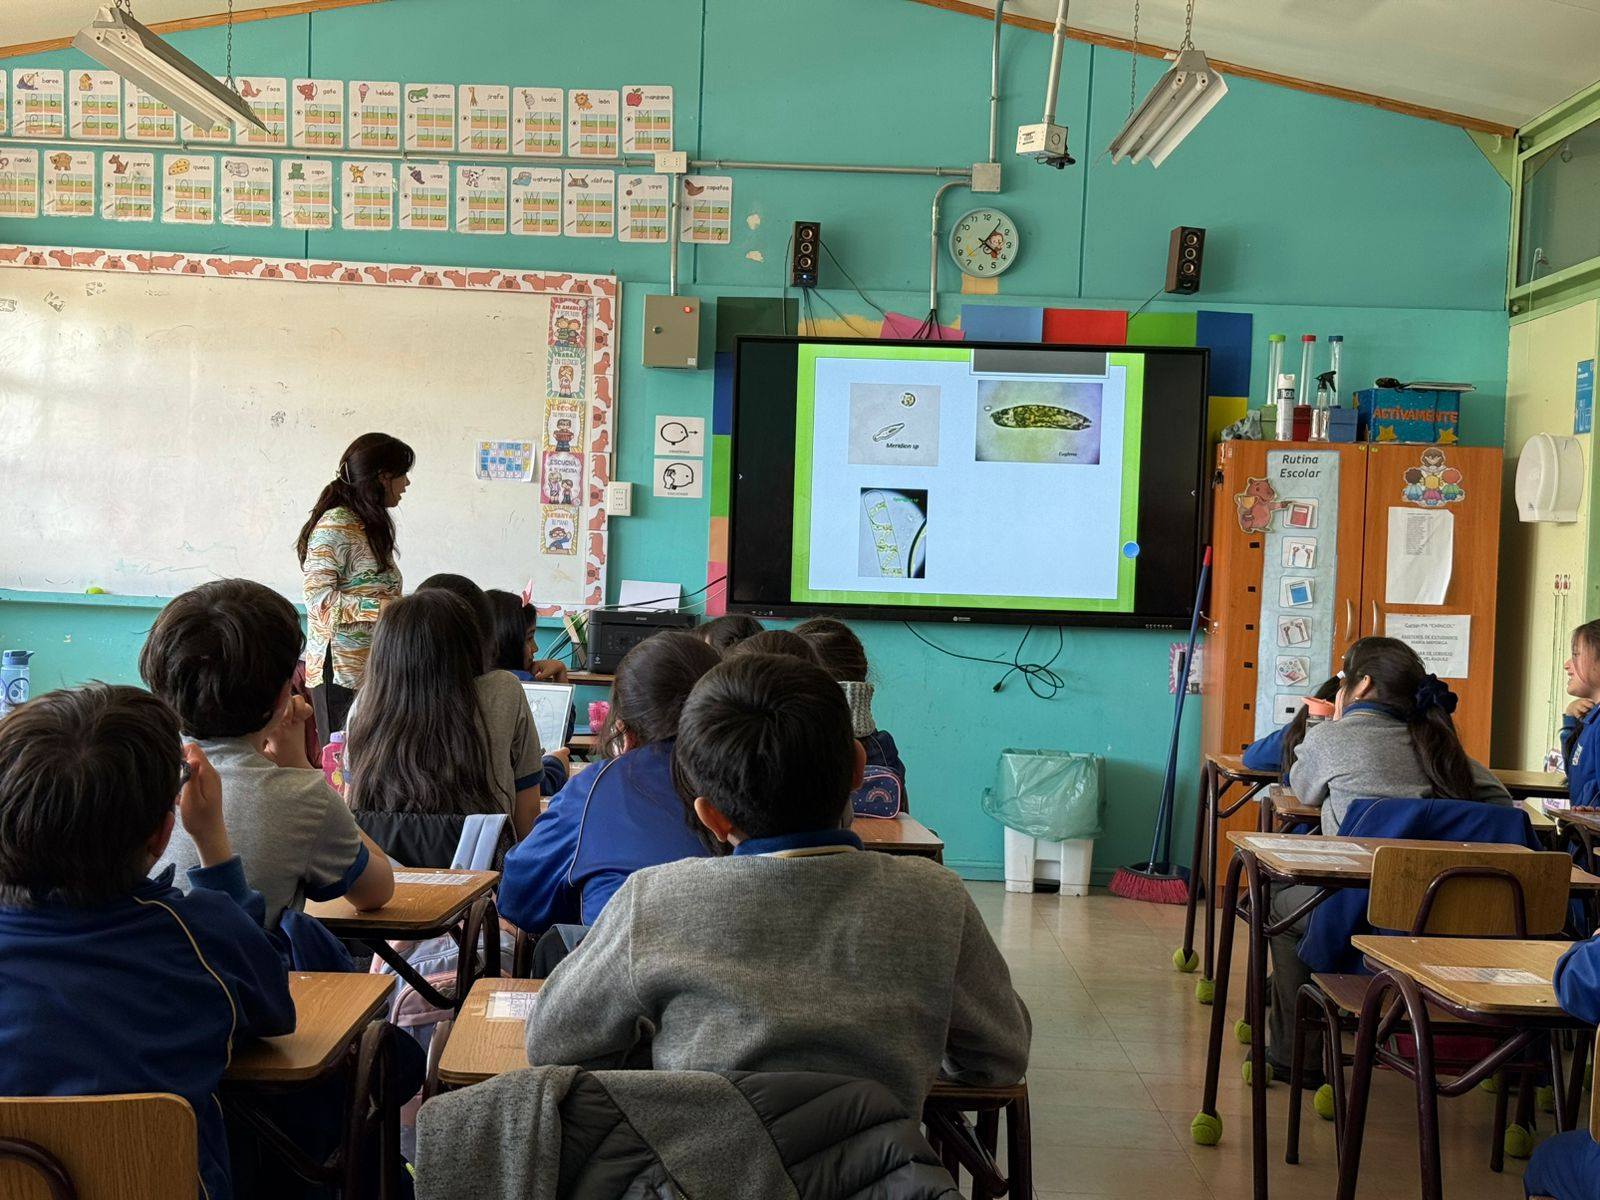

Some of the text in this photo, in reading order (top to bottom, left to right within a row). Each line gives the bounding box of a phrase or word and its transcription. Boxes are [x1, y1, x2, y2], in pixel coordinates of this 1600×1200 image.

[1373, 406, 1459, 423] ACTIVAMENTE
[1282, 454, 1319, 465] Rutina
[1280, 469, 1321, 479] Escolar
